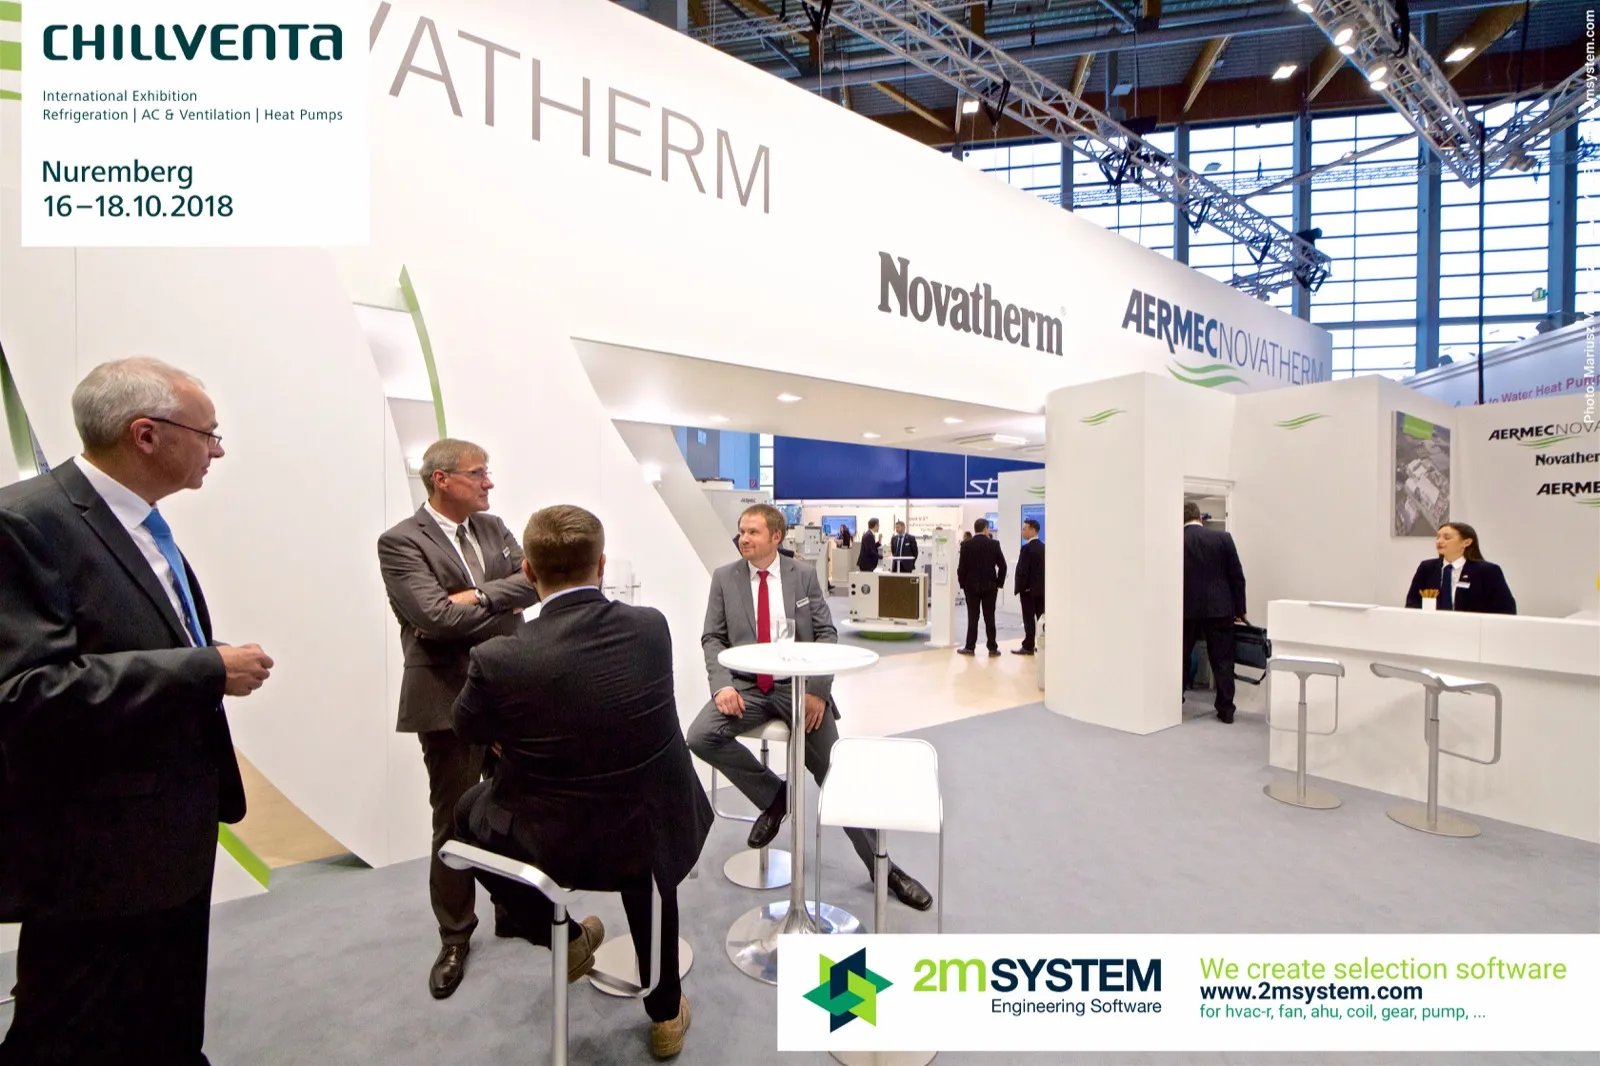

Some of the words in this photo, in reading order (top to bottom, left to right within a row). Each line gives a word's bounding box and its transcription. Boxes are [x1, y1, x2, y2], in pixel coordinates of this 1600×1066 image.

[878, 251, 1063, 357] Novatherm
[1502, 389, 1533, 402] Water
[1536, 381, 1562, 396] Heat
